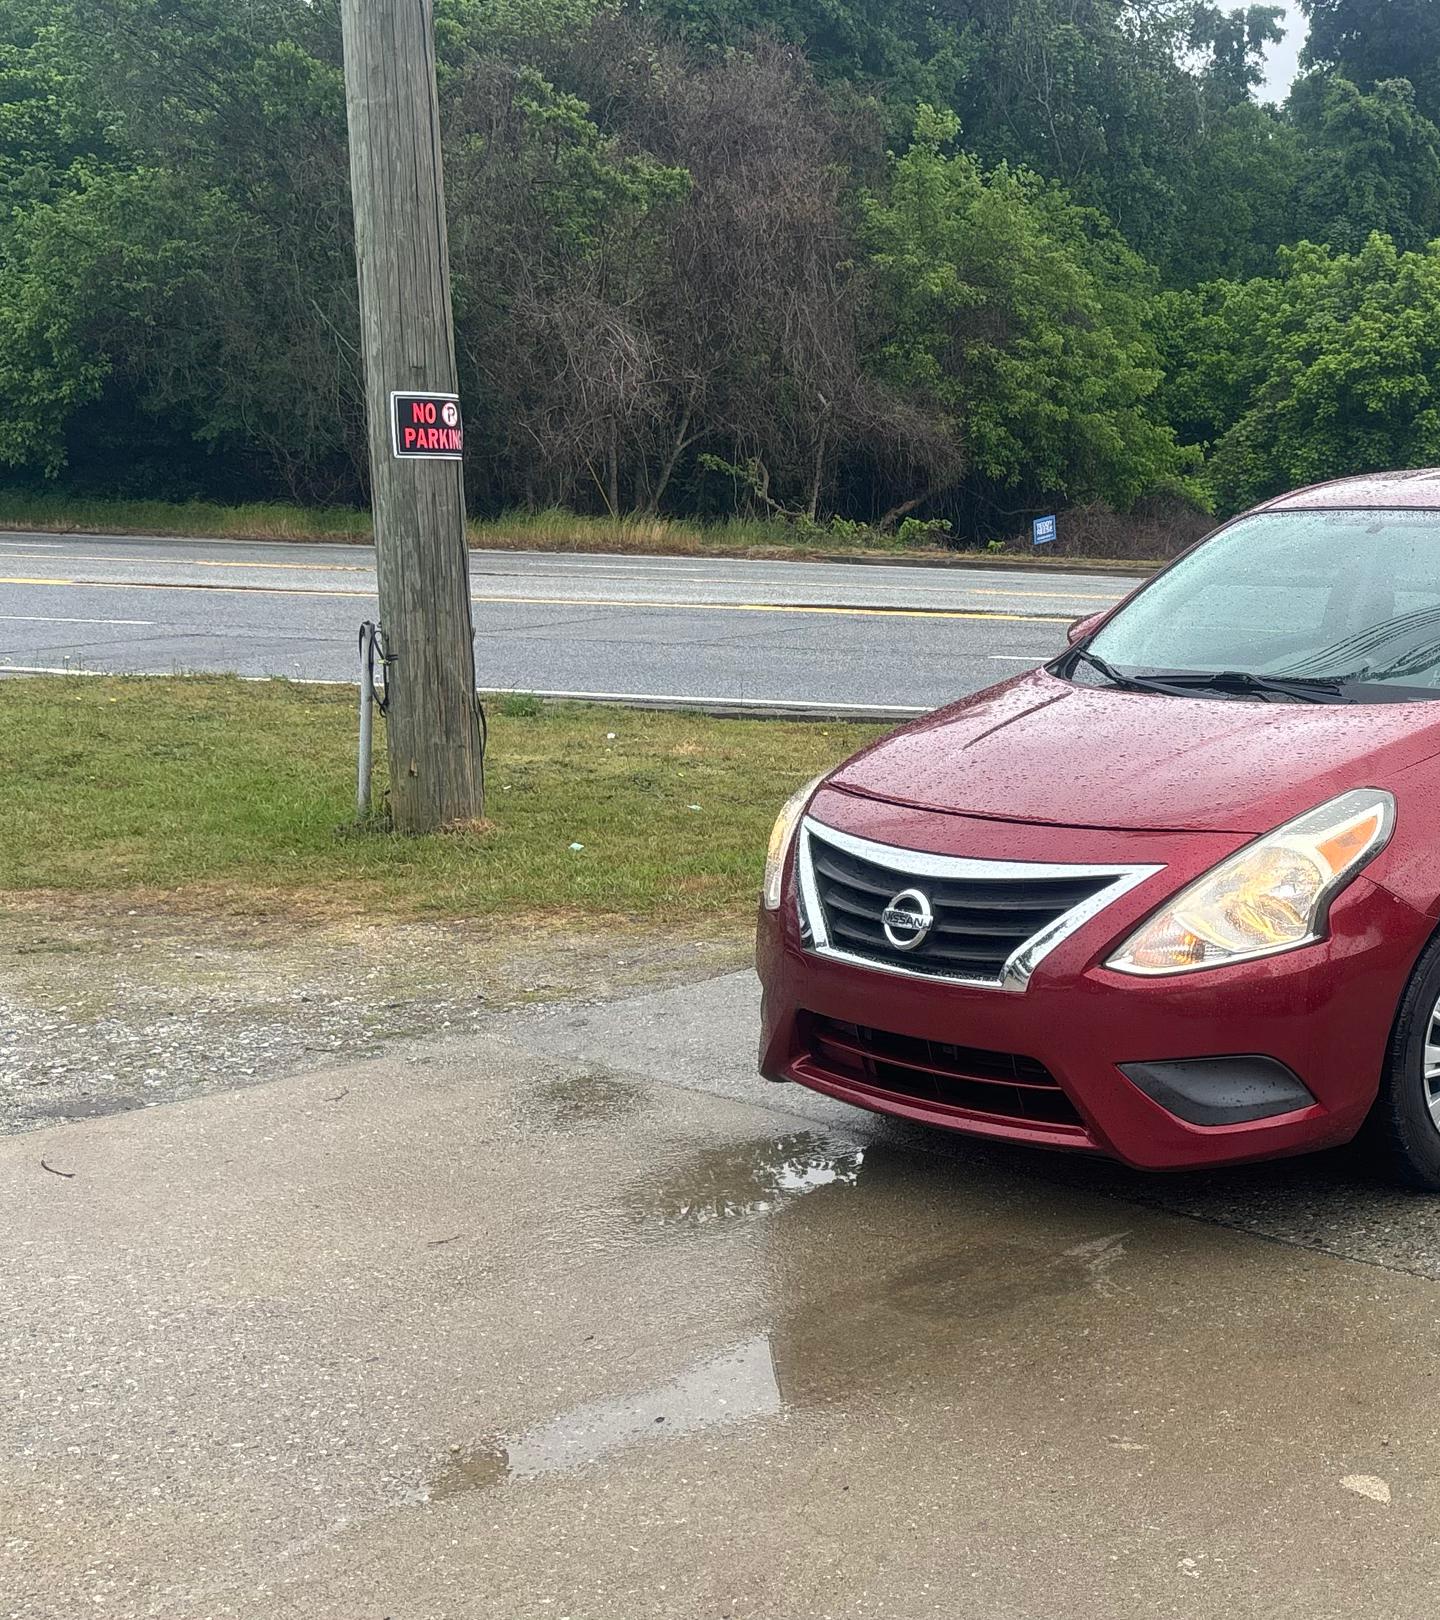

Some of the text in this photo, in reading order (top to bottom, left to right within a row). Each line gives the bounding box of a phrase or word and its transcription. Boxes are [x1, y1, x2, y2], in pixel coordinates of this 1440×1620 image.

[412, 402, 437, 424] NO
[404, 427, 463, 449] PARKIN
[884, 911, 924, 926] NISSAN
